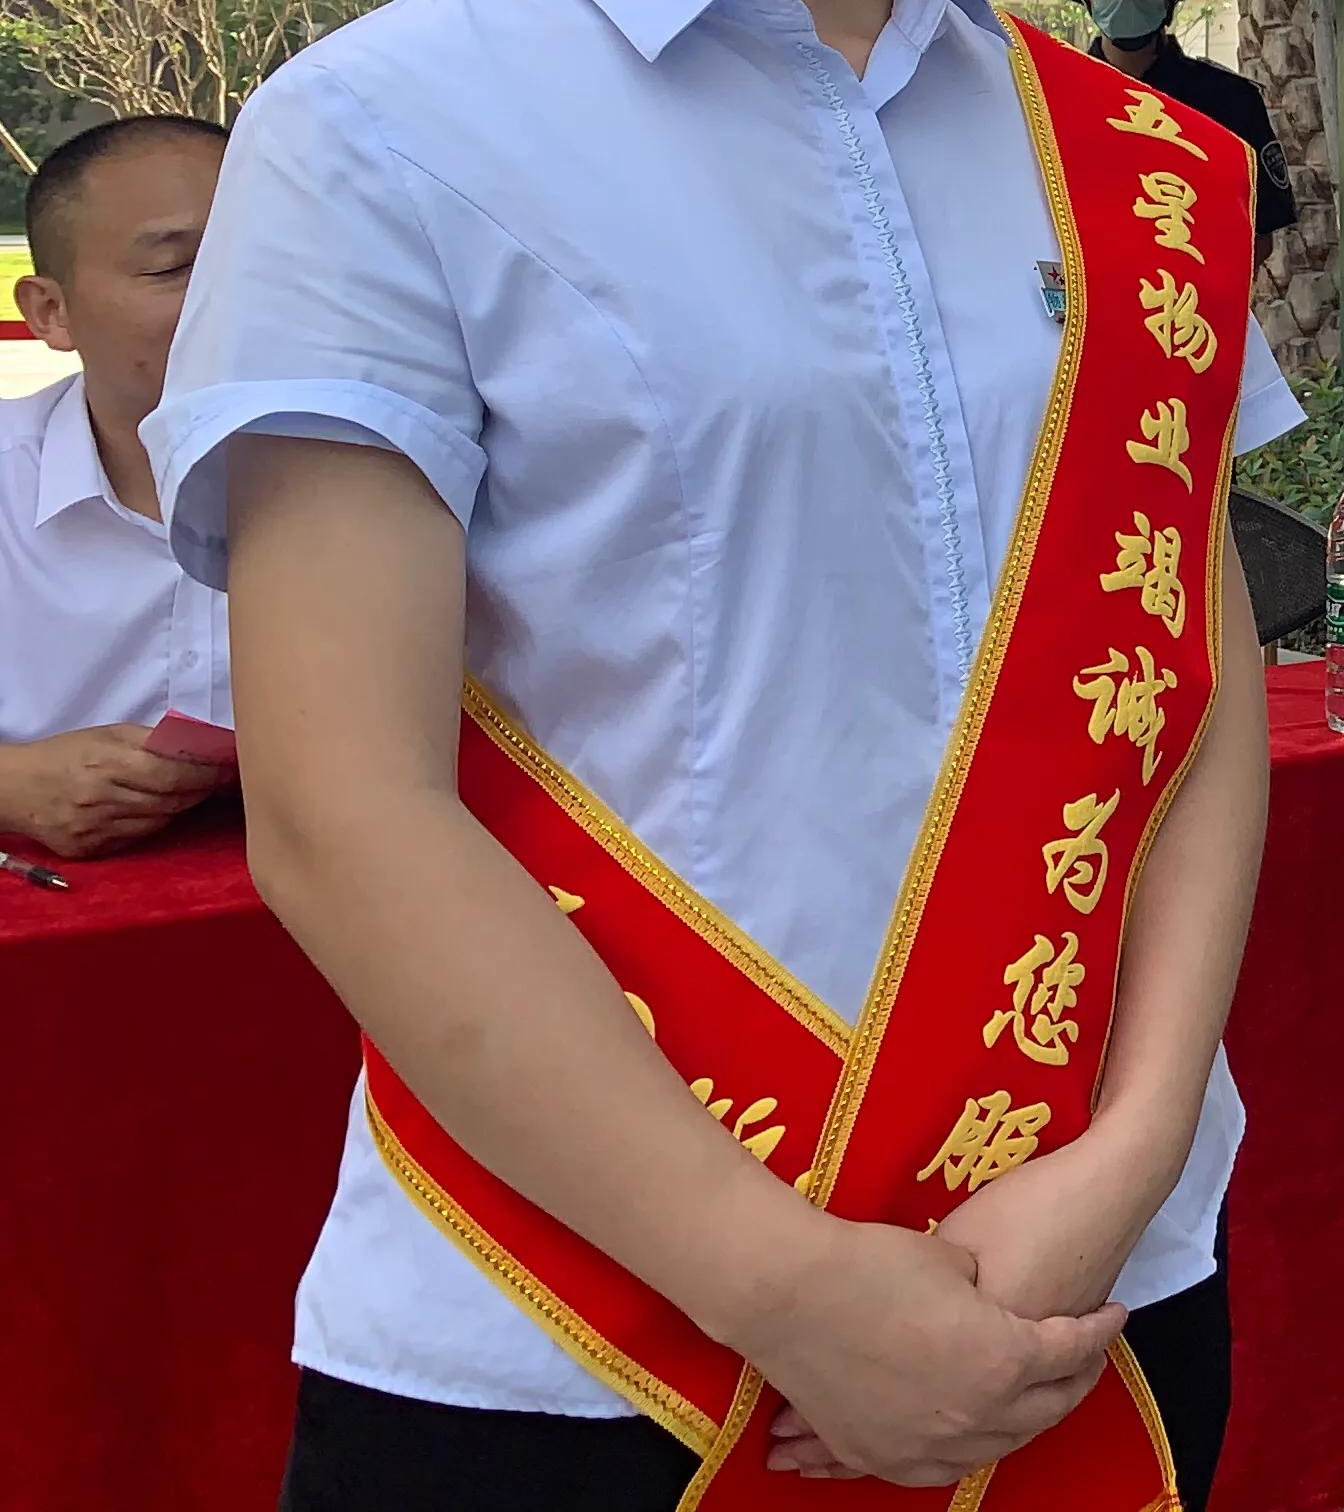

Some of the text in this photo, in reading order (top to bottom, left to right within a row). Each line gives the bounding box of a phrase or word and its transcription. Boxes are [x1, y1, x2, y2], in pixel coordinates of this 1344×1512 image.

[917, 88, 1218, 1235] 五星物业竭诚为您服
